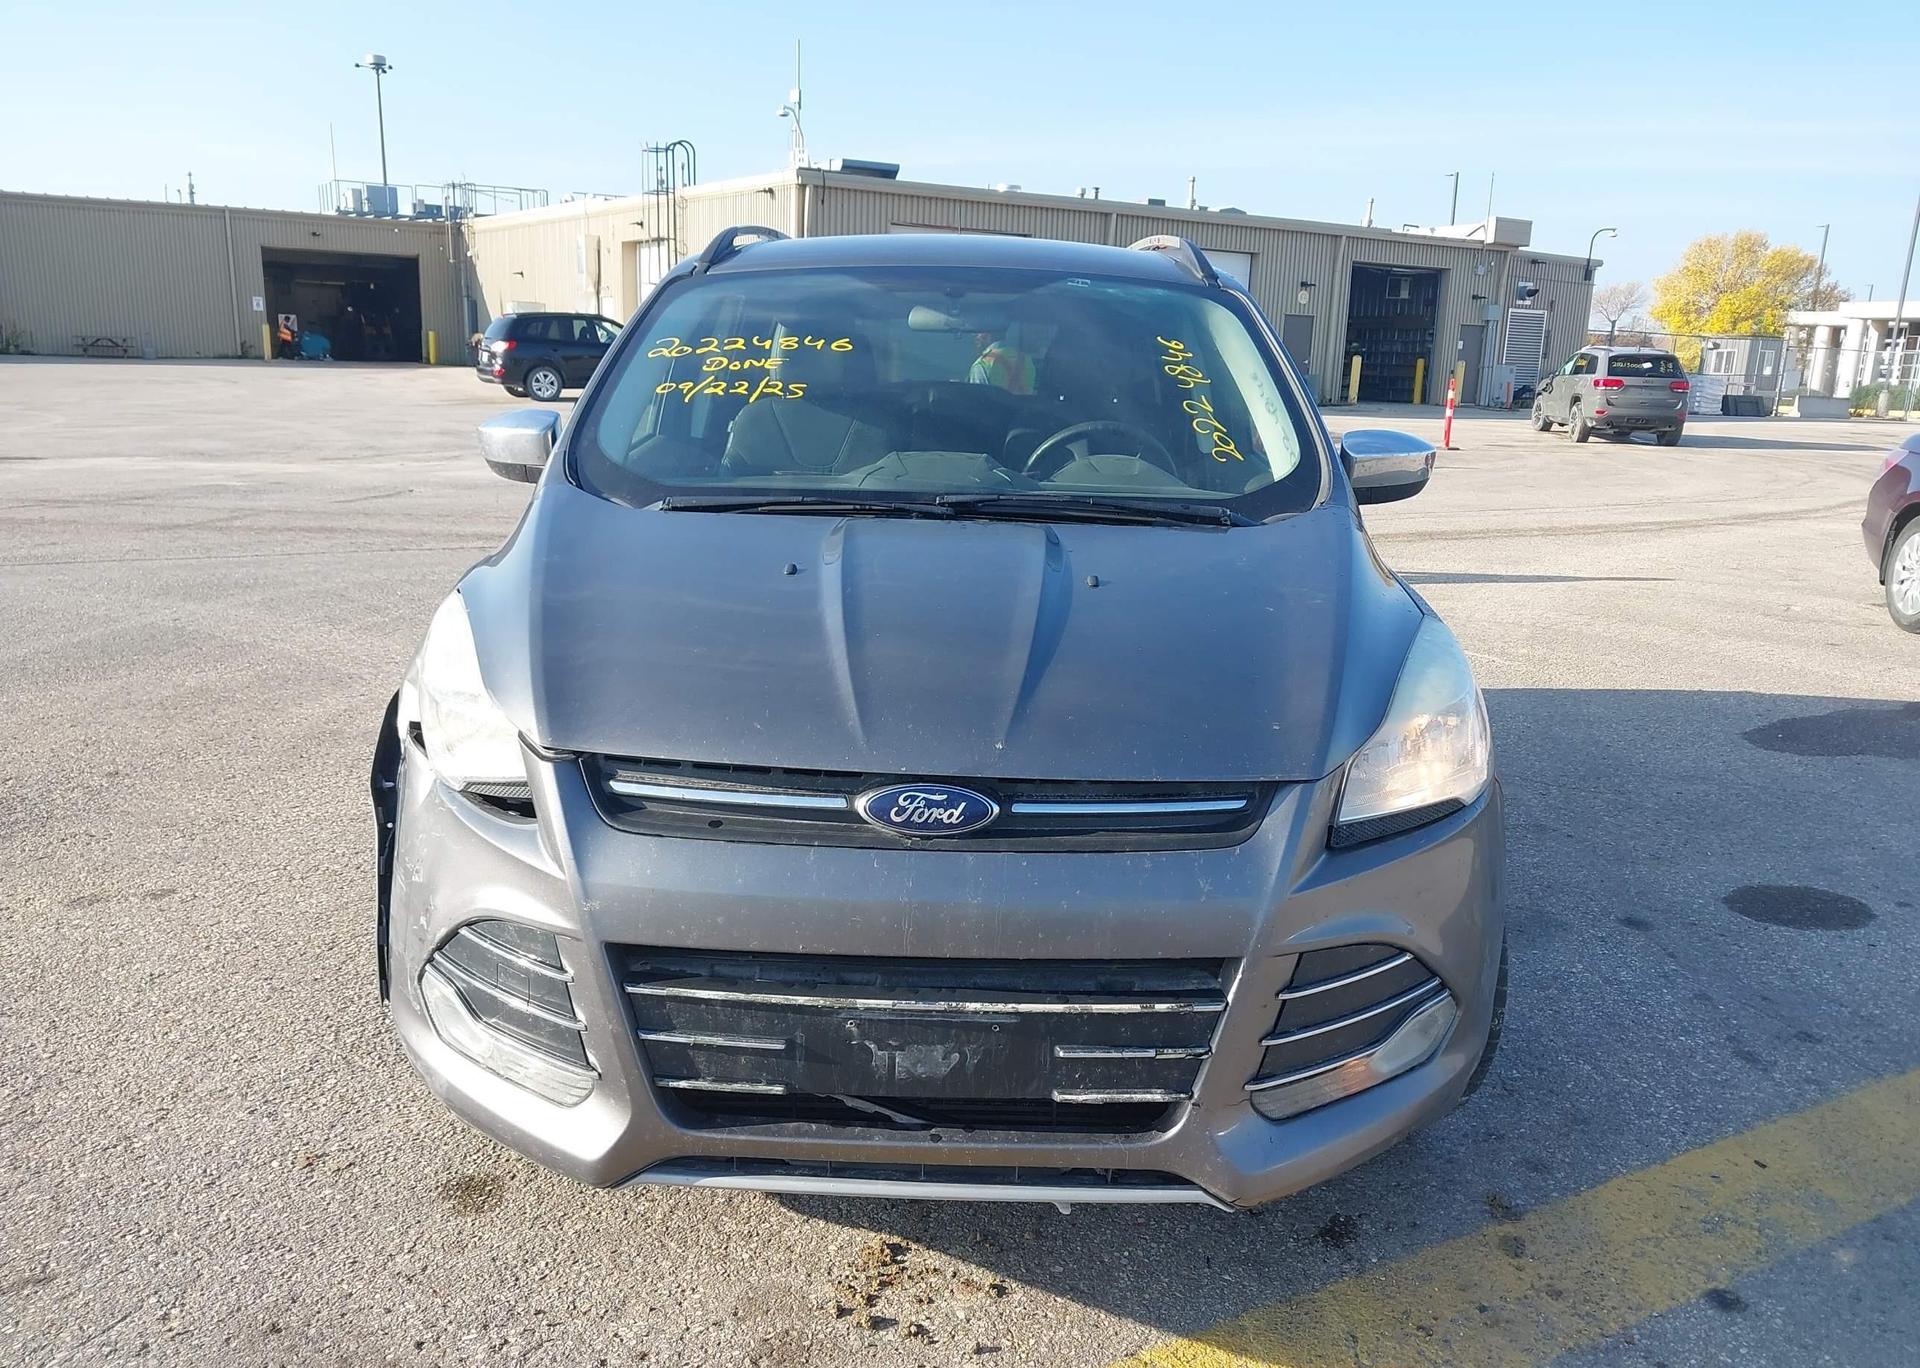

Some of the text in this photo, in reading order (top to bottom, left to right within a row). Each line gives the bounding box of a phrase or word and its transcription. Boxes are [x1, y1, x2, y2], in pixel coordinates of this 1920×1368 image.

[647, 335, 854, 359] 20224846
[702, 356, 790, 372] DONE
[655, 375, 808, 403] 09/22/25
[890, 791, 967, 825] Ford
